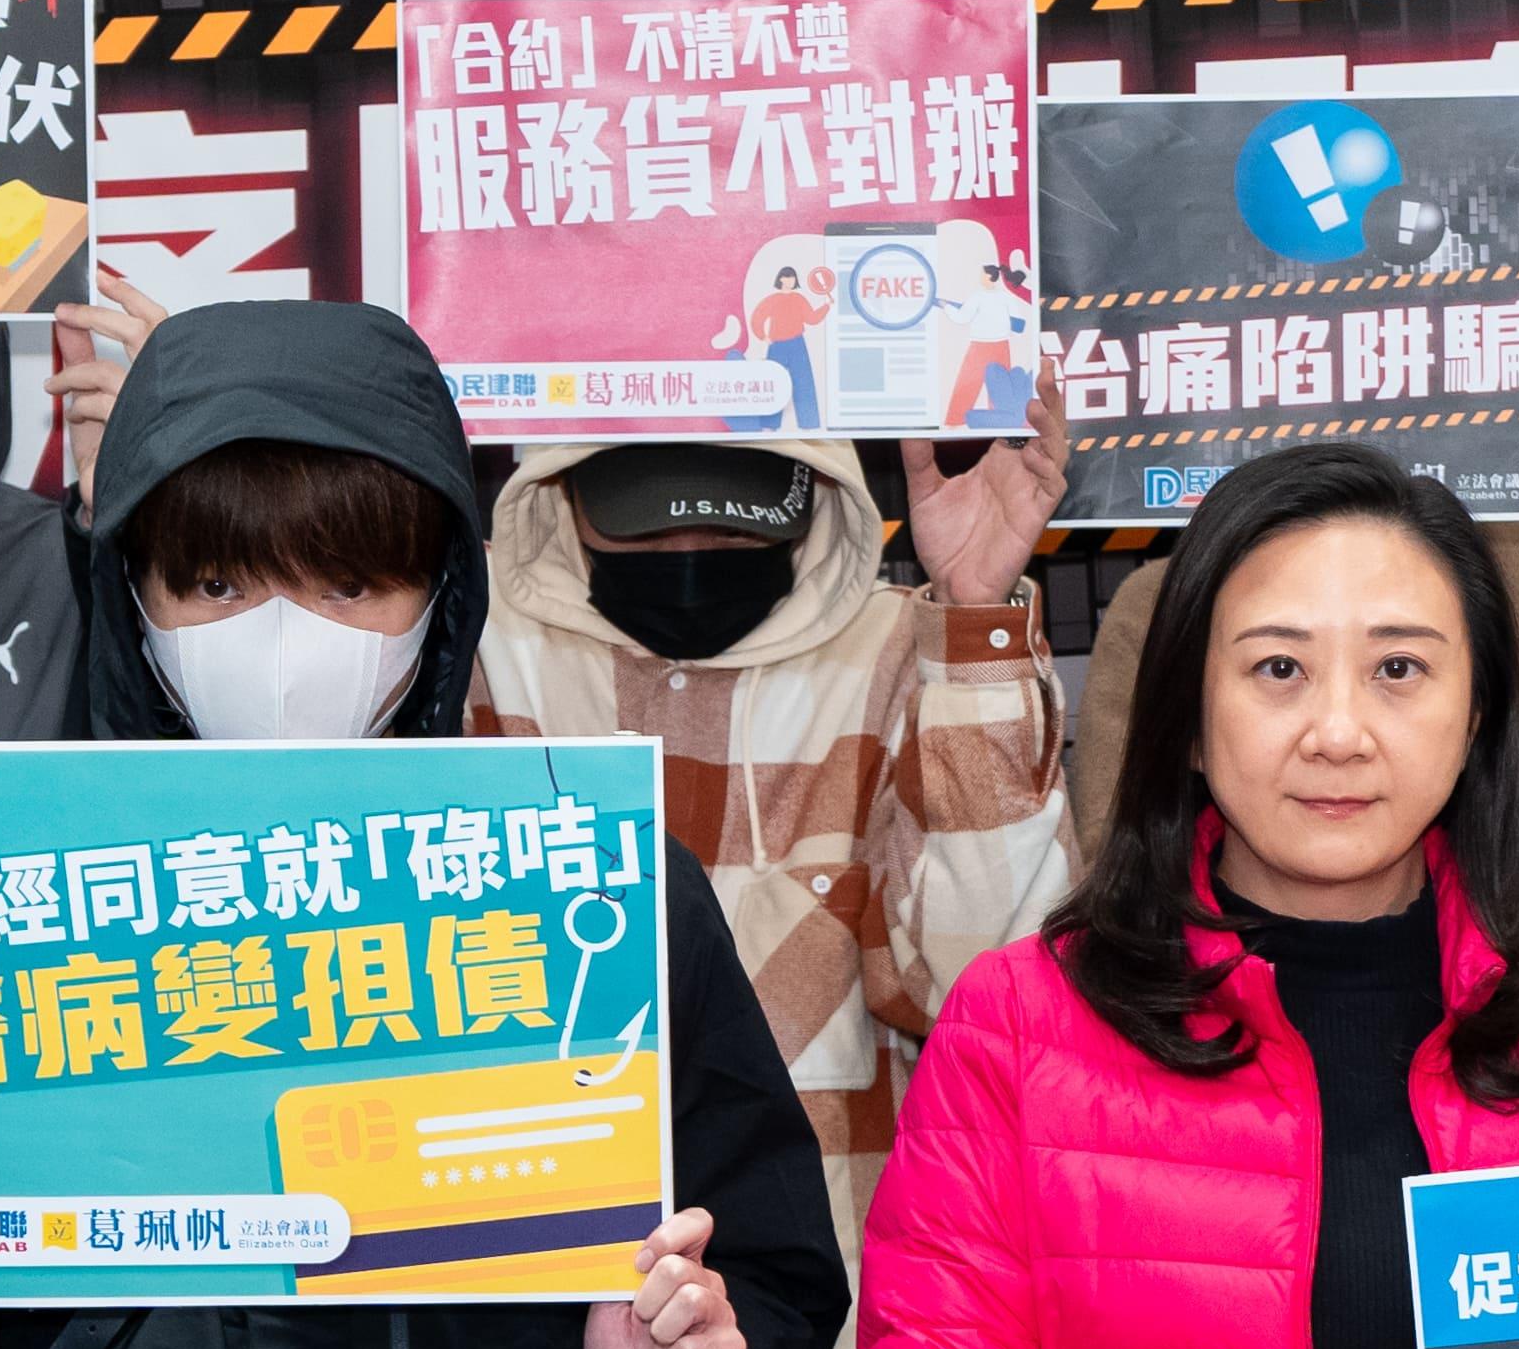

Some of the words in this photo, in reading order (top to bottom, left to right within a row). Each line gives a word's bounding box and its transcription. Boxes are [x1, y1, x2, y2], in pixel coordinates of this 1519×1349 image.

[414, 72, 1020, 233] 服務貨不對辦
[860, 276, 925, 301] FAKE
[462, 373, 536, 396] 民建聯
[583, 371, 697, 406] 葛珮帆
[498, 399, 536, 407] DAB
[670, 500, 720, 516] U.S.
[725, 501, 788, 526] ALPHA
[84, 1208, 231, 1251] 葛珮帆
[239, 1220, 329, 1237] 立法會議員
[238, 1239, 296, 1249] Elizabeth
[300, 1239, 329, 1248] Quat
